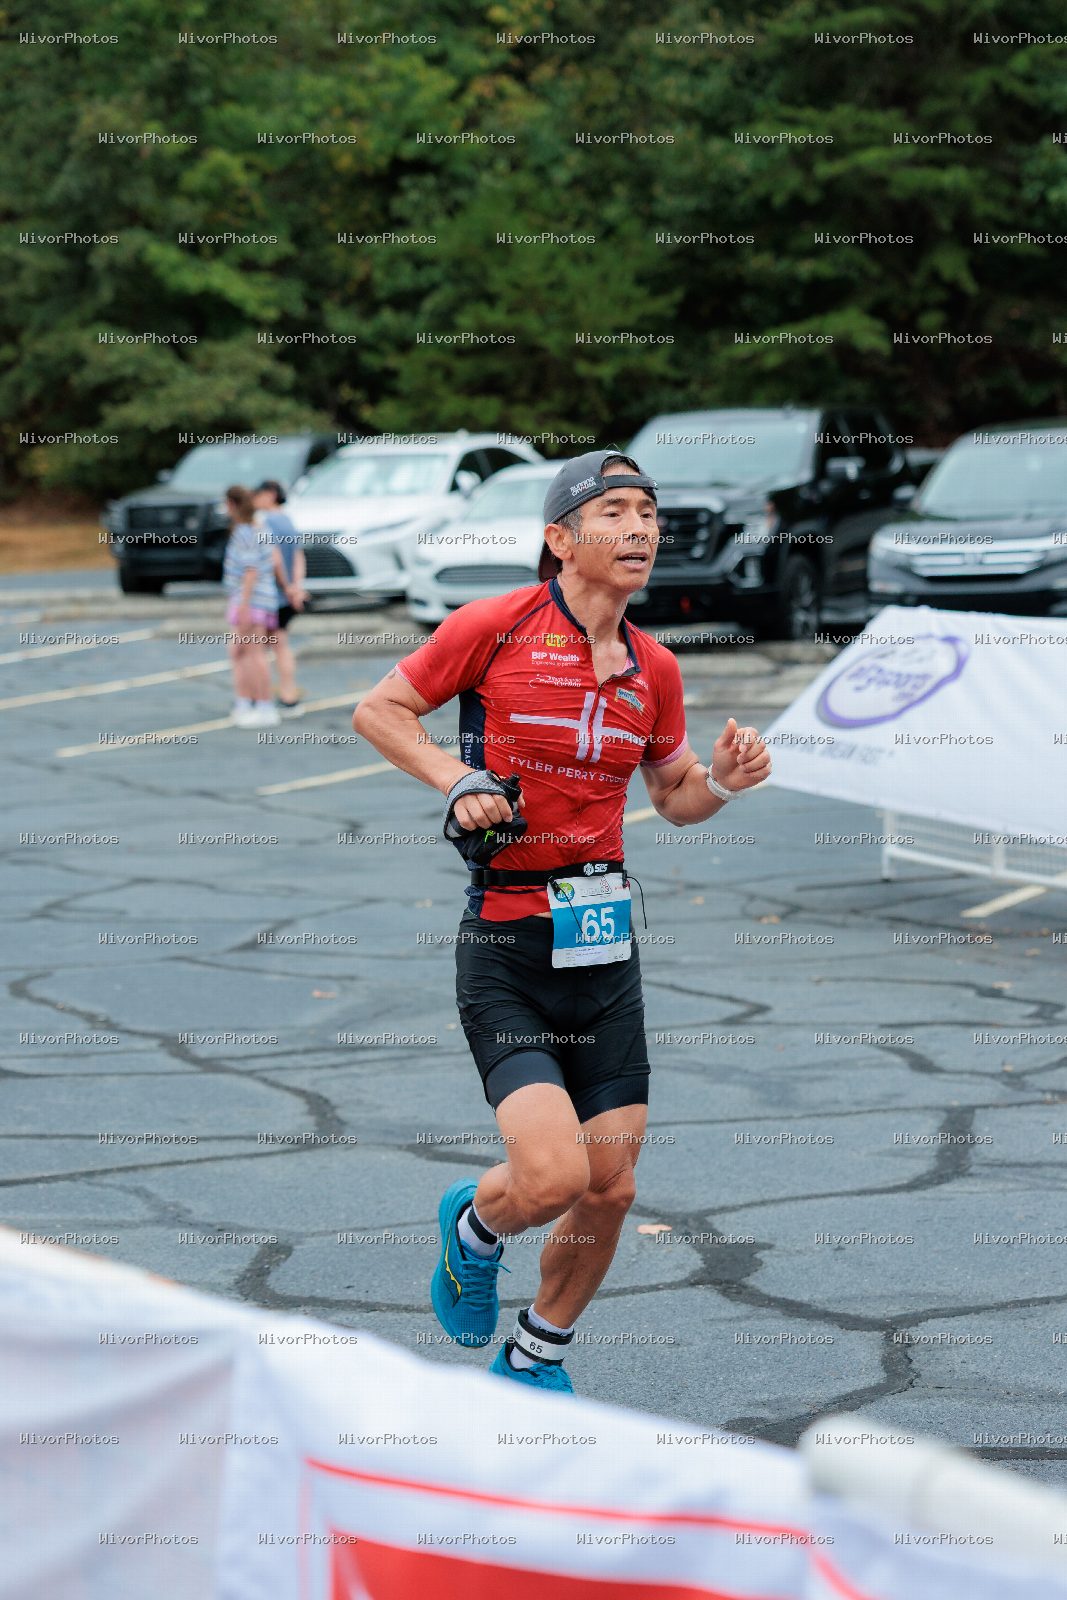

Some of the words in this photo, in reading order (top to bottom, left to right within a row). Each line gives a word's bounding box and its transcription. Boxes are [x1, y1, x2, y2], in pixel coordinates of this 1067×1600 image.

[531, 651, 548, 660] BIP
[549, 652, 579, 662] Wealth
[508, 755, 554, 774] TYLER
[557, 766, 597, 781] PERRY
[582, 906, 616, 942] 65
[529, 1341, 544, 1354] 65
